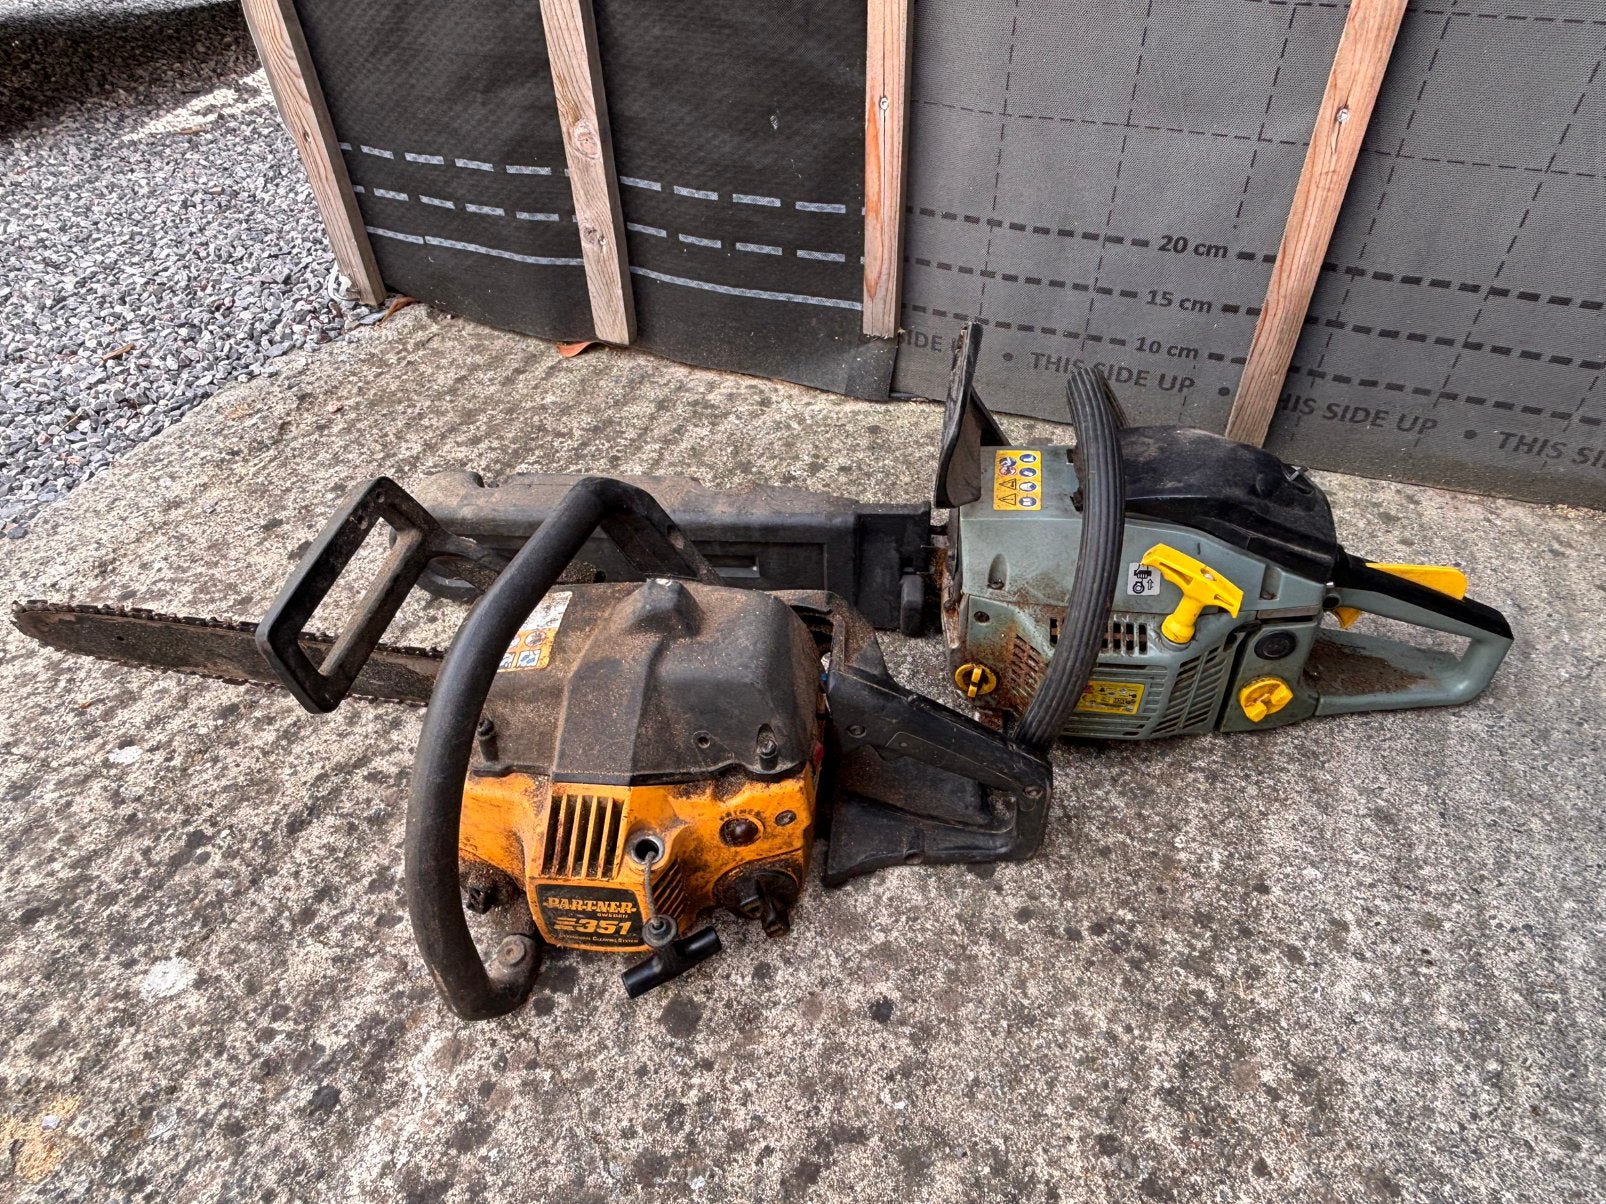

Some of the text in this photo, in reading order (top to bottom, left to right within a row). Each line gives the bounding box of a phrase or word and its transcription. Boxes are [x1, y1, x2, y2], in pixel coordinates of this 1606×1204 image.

[1157, 235, 1229, 258] 20 cm
[1146, 290, 1213, 314] 15 cm
[1135, 337, 1199, 360] 10 cm
[1030, 352, 1085, 375] THIS
[1158, 374, 1196, 393] UP
[1279, 393, 1438, 435] HIS SIDE UP
[1499, 431, 1606, 469] THIS SI
[543, 896, 637, 914] PARTNER
